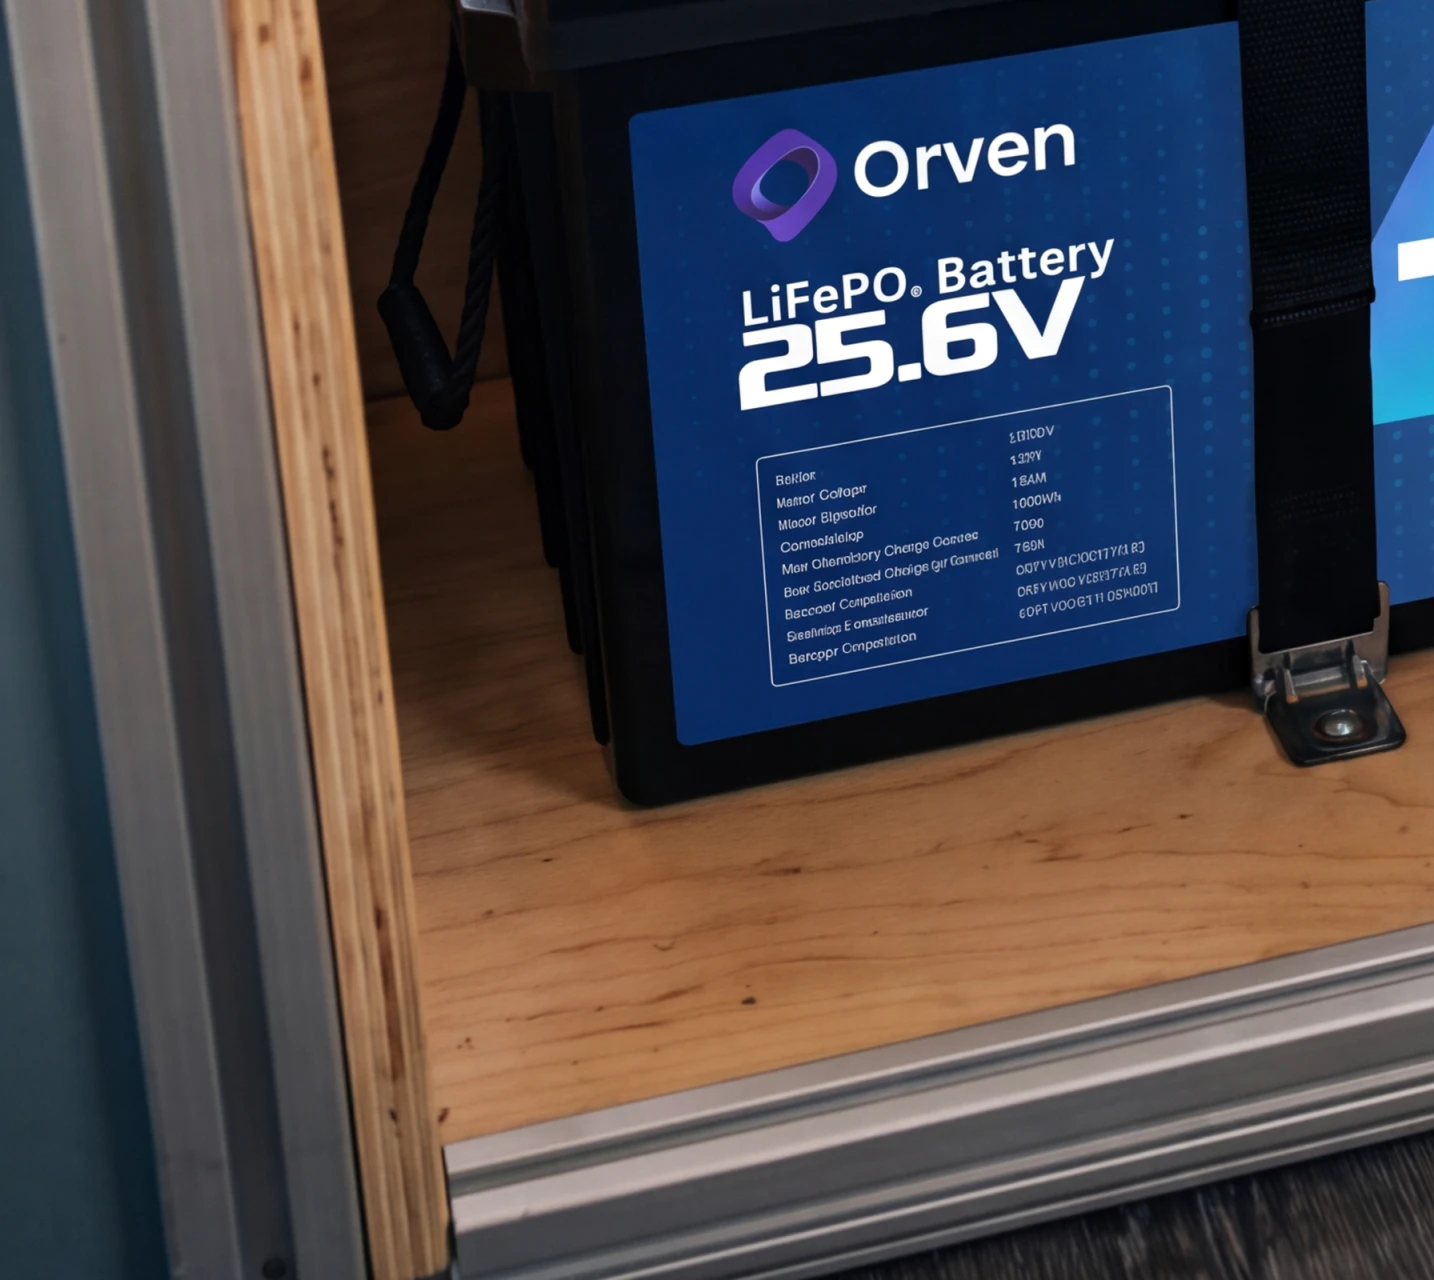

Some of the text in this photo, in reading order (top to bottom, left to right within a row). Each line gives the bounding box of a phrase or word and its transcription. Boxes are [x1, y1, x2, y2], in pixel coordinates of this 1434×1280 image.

[854, 123, 1076, 198] Orven
[937, 238, 1115, 294] Battery
[738, 276, 1086, 411] 25.6V
